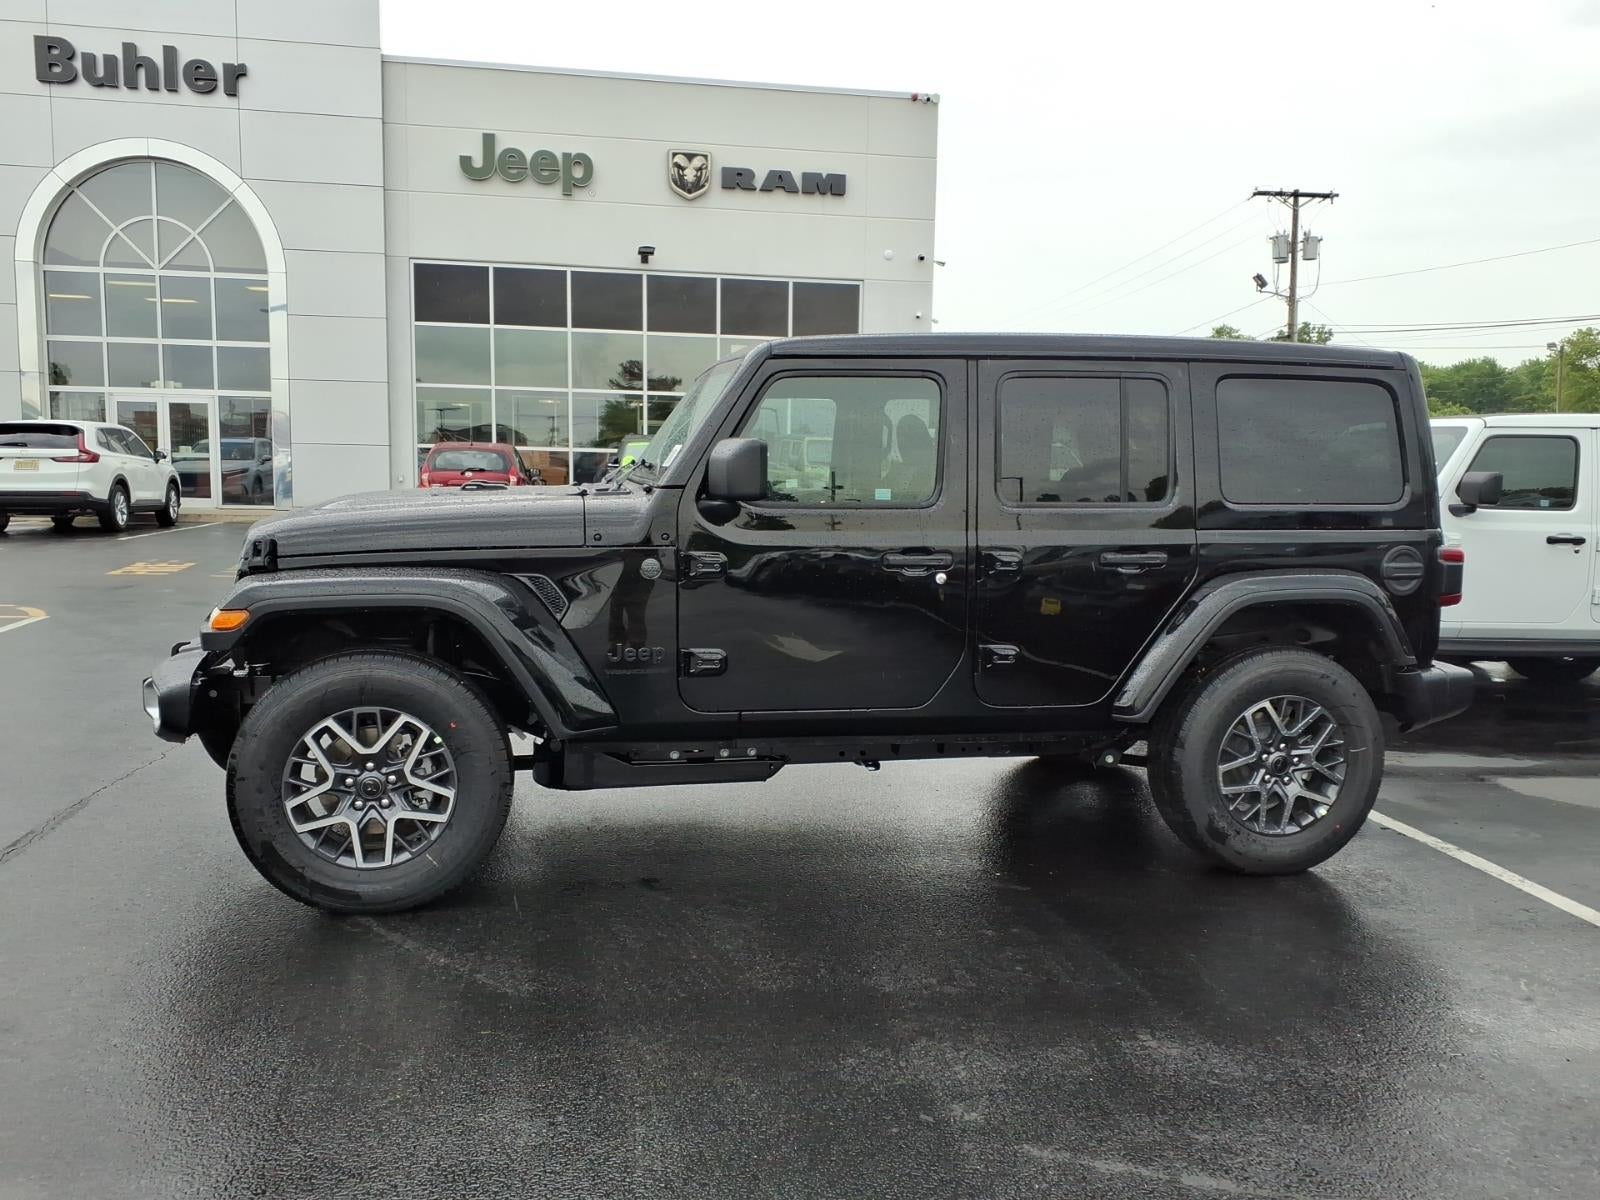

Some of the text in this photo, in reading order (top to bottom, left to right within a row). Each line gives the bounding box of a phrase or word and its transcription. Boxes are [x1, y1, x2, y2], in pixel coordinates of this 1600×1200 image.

[33, 34, 247, 97] Buhler
[459, 133, 594, 195] Jeep
[721, 166, 847, 196] RAM
[607, 643, 665, 664] Jeep
